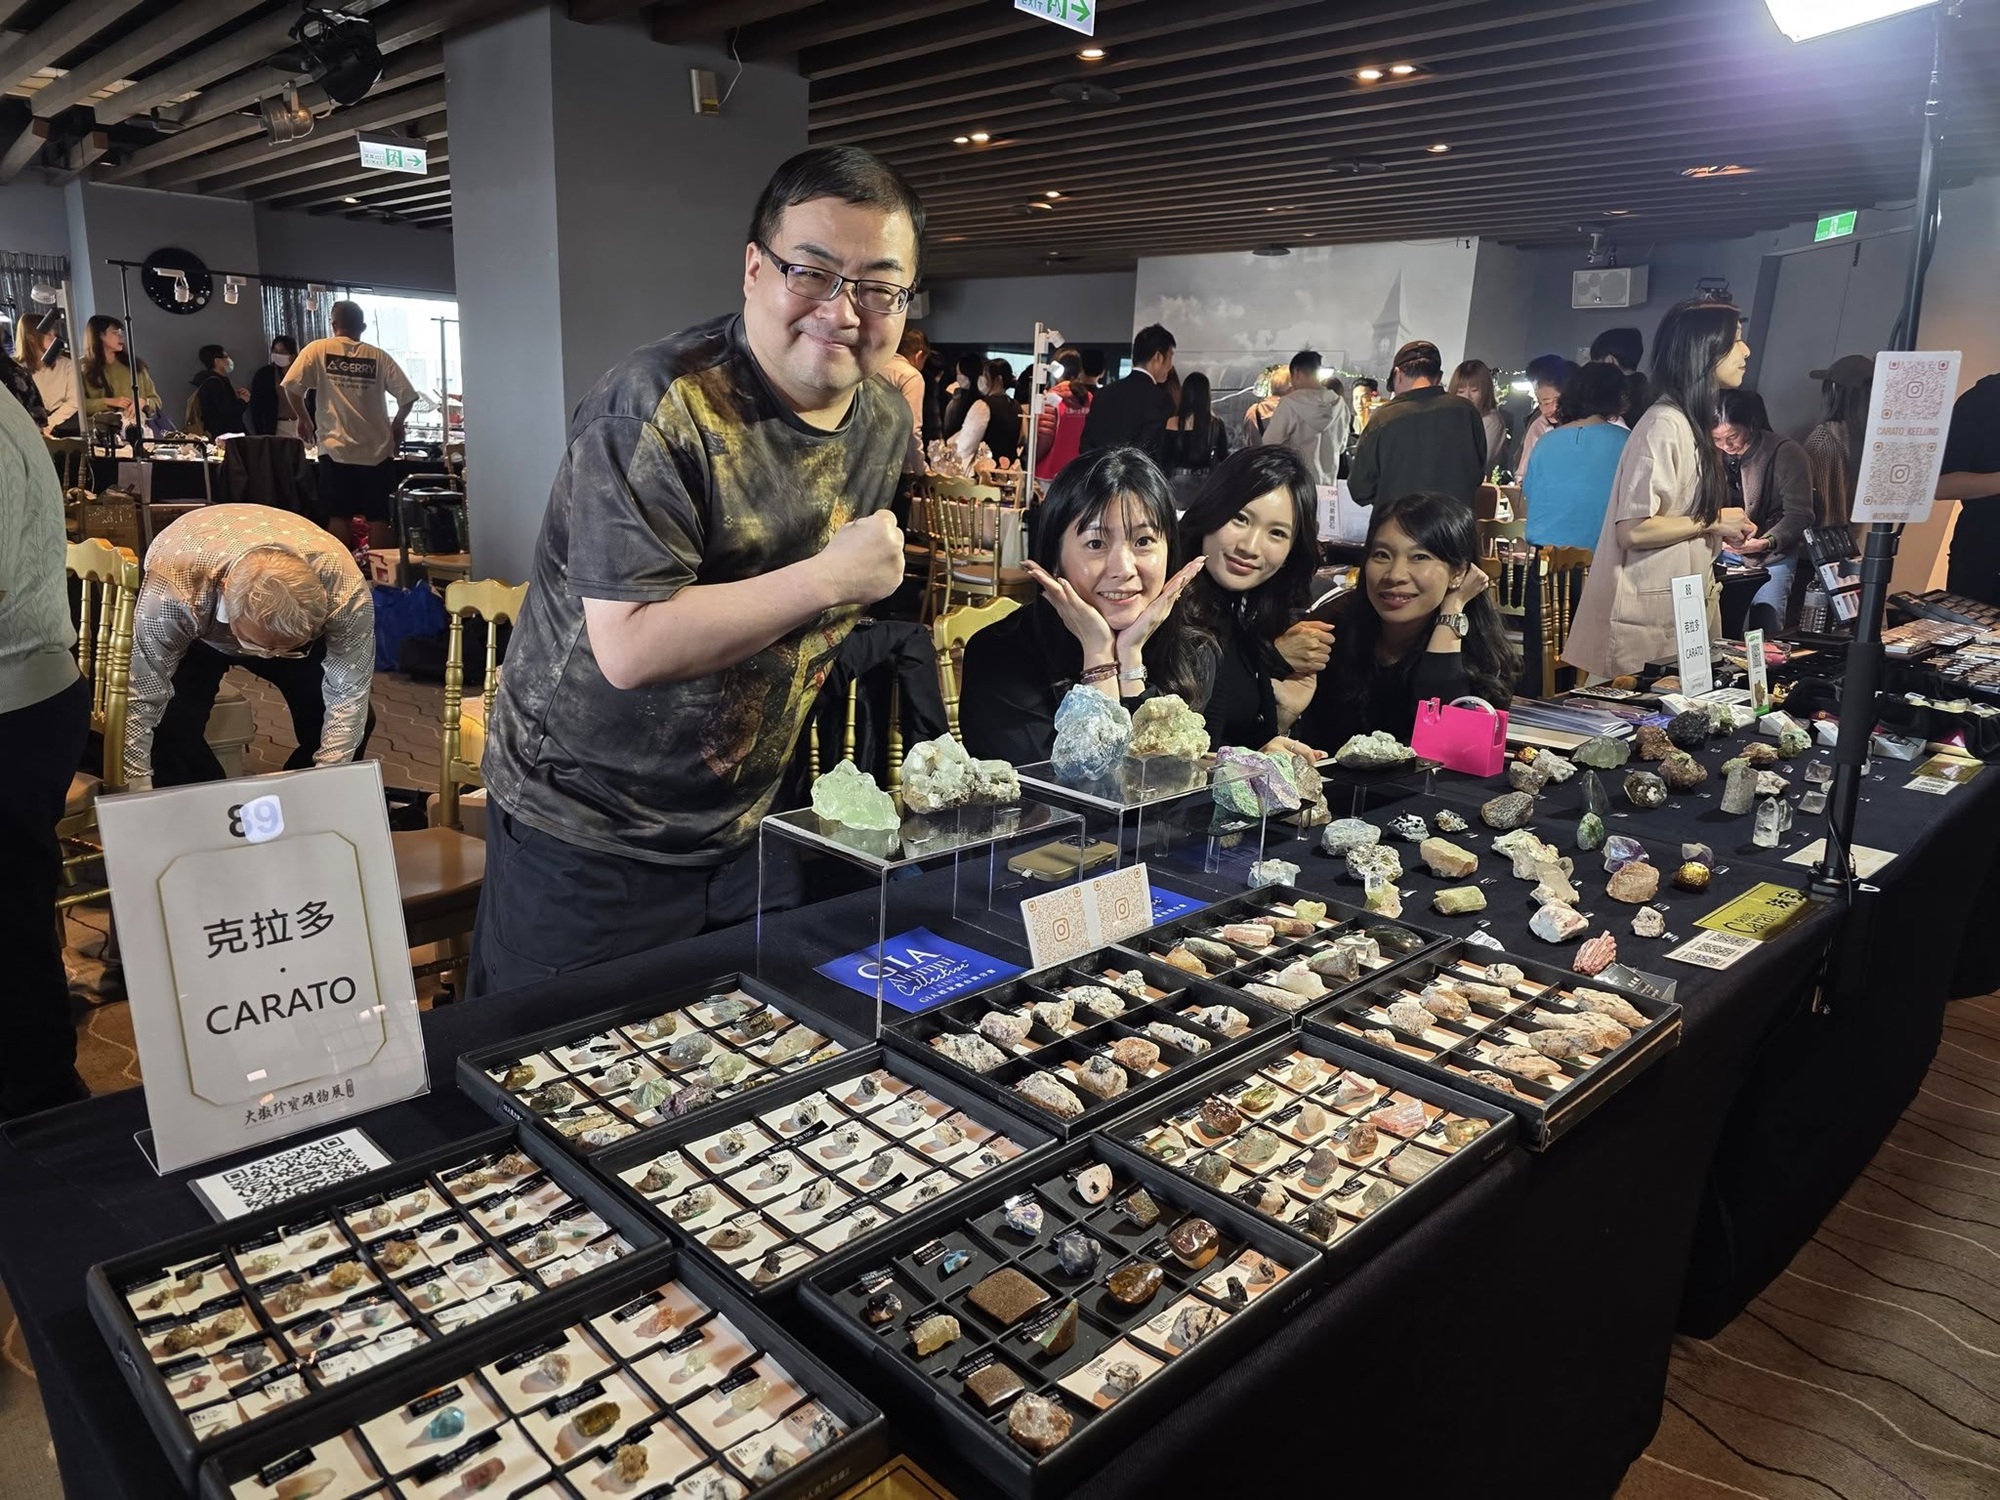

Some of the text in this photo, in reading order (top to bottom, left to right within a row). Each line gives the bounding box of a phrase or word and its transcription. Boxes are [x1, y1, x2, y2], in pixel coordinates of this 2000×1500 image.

[339, 361, 375, 373] GERRY
[1685, 645, 1704, 659] CARATO
[203, 900, 335, 959] 克拉多
[858, 949, 942, 980] GIA
[888, 957, 956, 987] Alumni
[930, 972, 970, 990] TAIWAN
[206, 976, 356, 1035] CARATO
